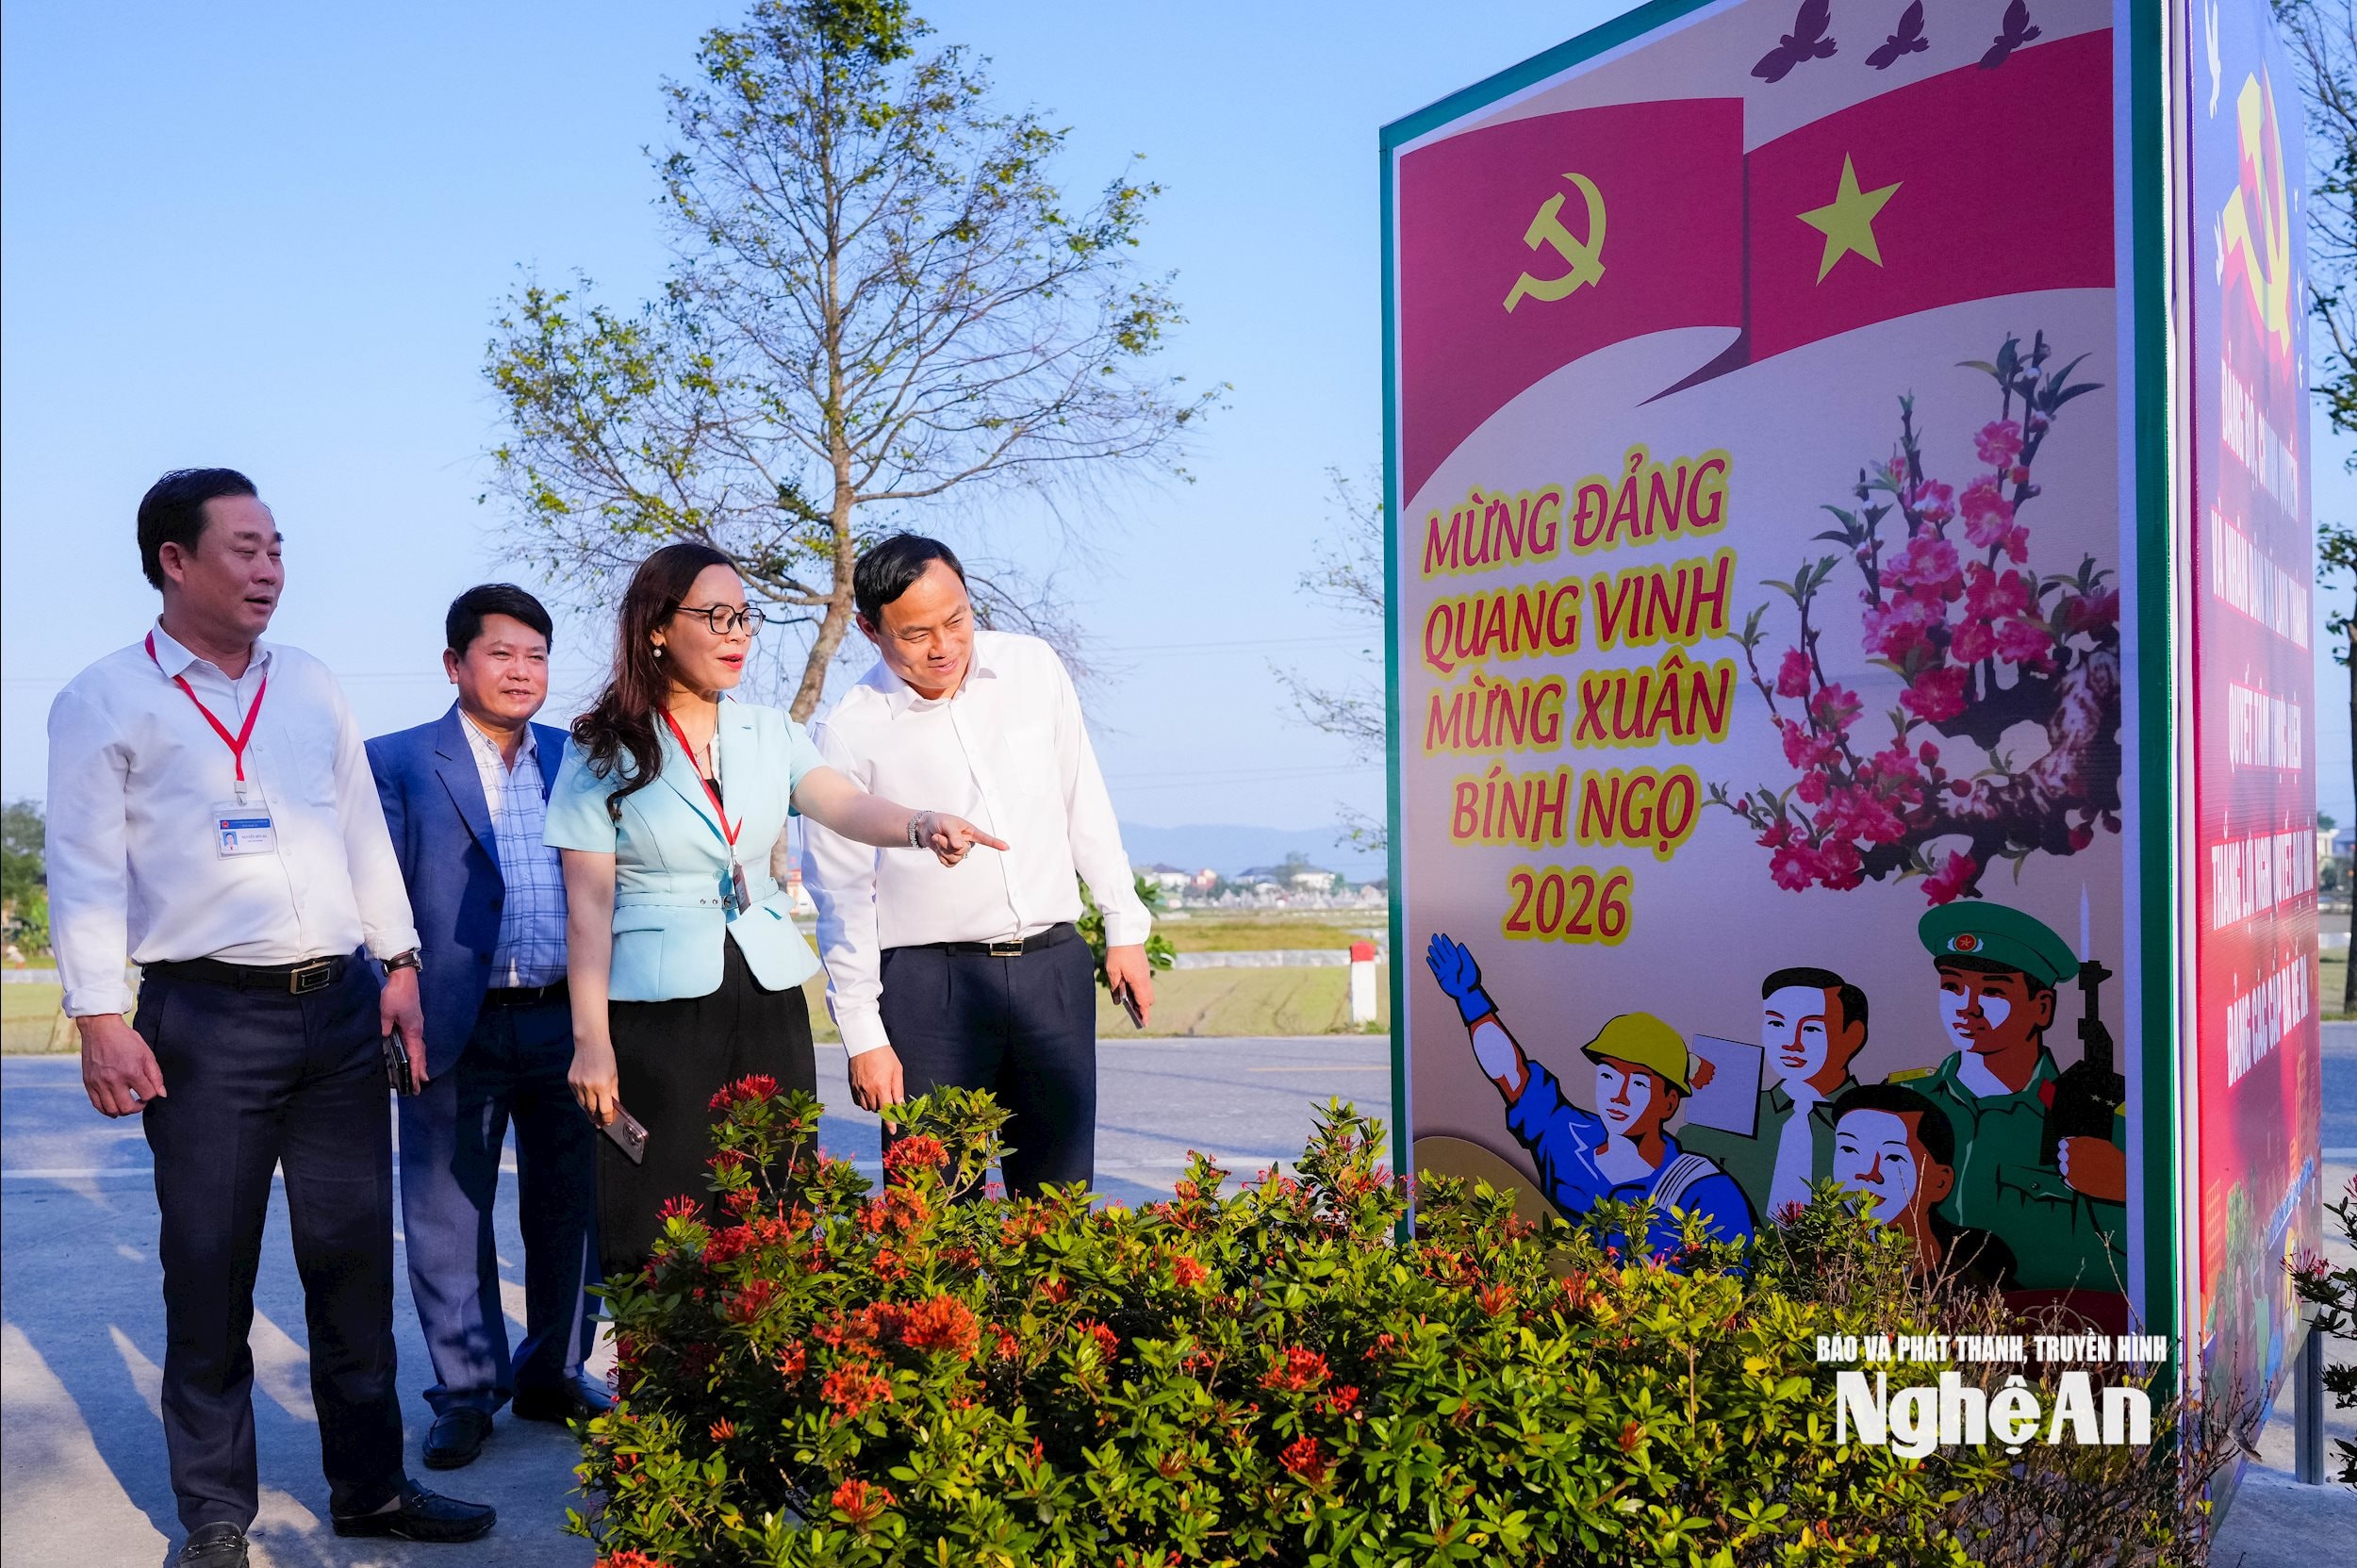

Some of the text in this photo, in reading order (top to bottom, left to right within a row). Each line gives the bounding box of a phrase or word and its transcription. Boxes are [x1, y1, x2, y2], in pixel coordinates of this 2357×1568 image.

[1424, 453, 1726, 572] MỪNG ĐẢNG
[1425, 556, 1730, 674] QUANG VINH
[1426, 655, 1731, 751] MỪNG XUÂN
[1452, 766, 1696, 853] BÍNH NGỌ
[1506, 873, 1628, 937] 2026
